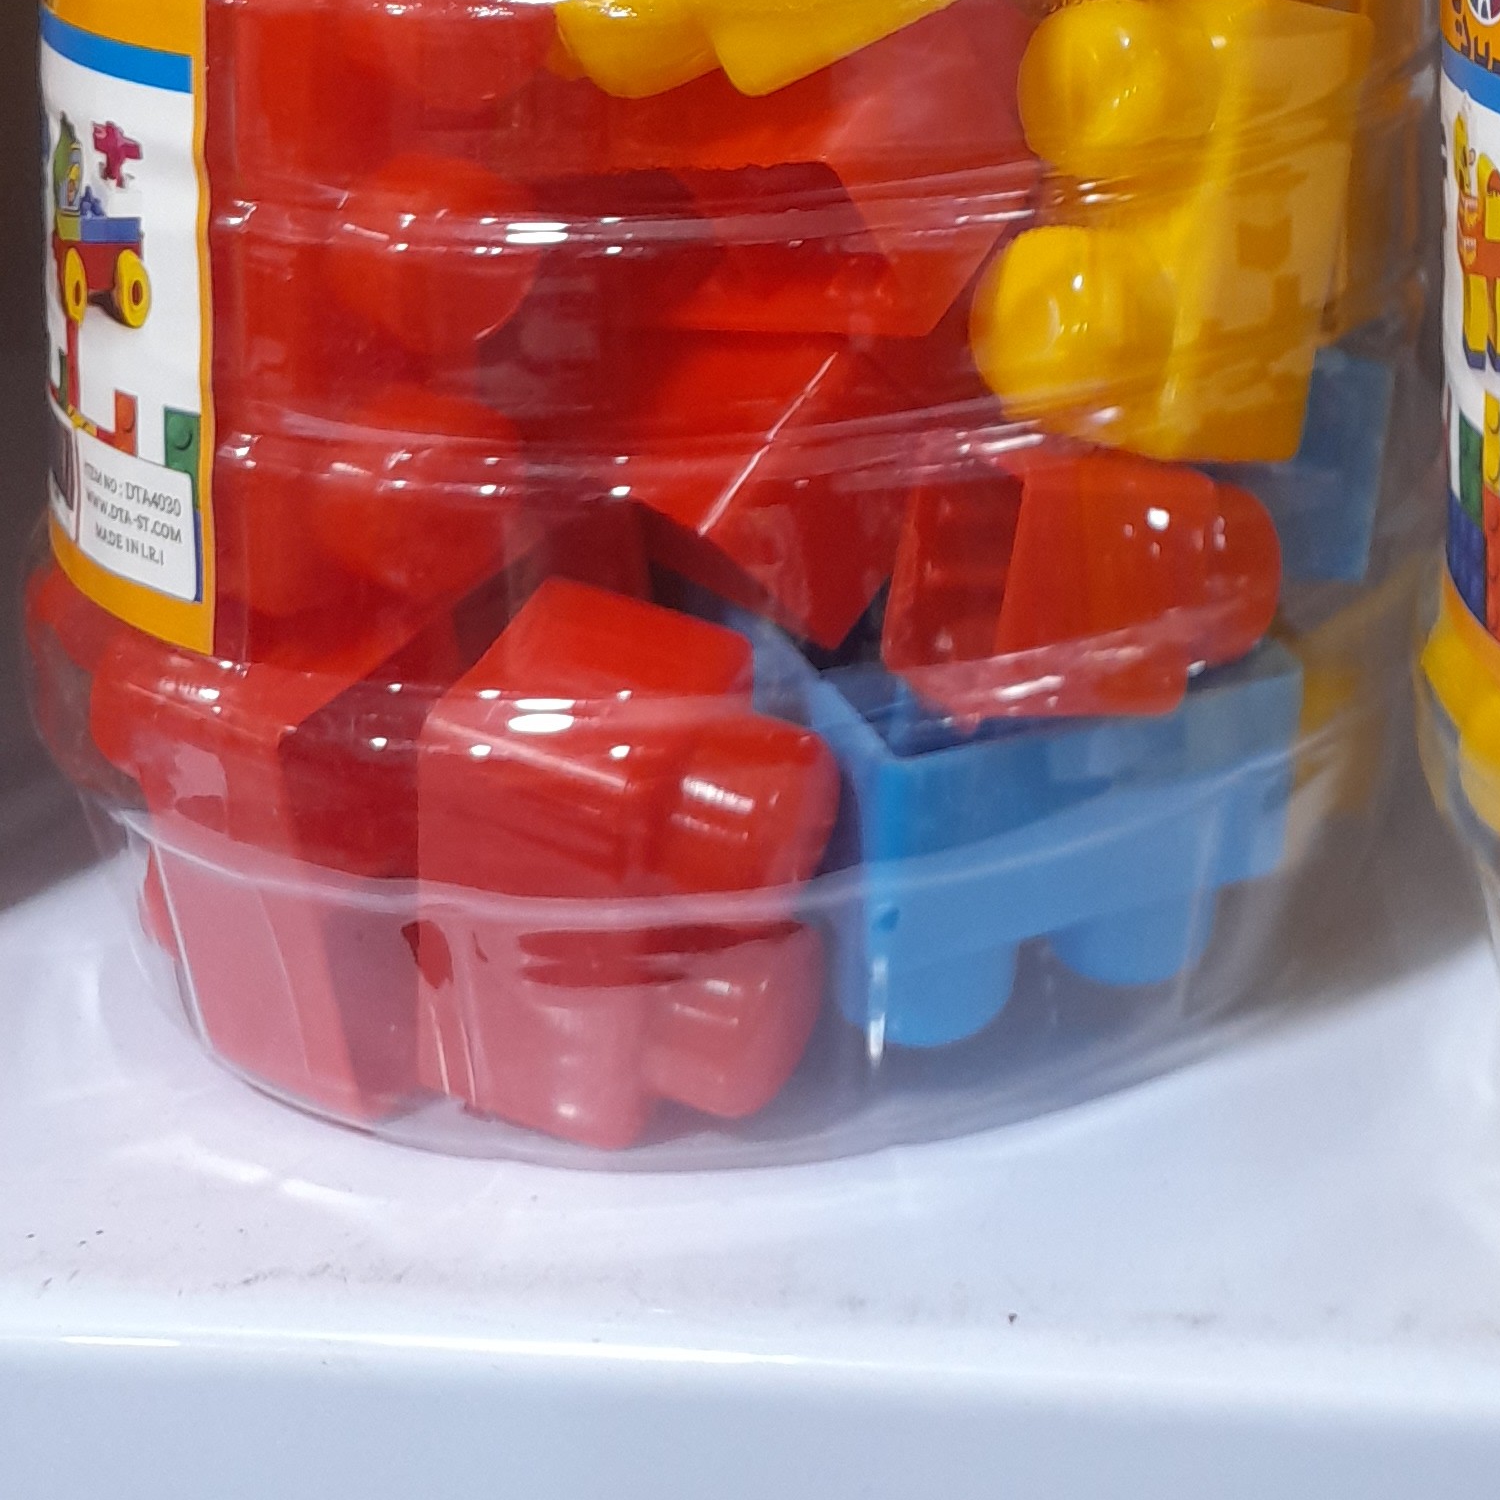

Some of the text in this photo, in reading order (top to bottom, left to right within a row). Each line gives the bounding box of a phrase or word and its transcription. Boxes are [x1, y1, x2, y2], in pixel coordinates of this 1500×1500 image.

[126, 481, 182, 518] DTA4030
[96, 521, 123, 551] MADE
[126, 537, 139, 555] IN
